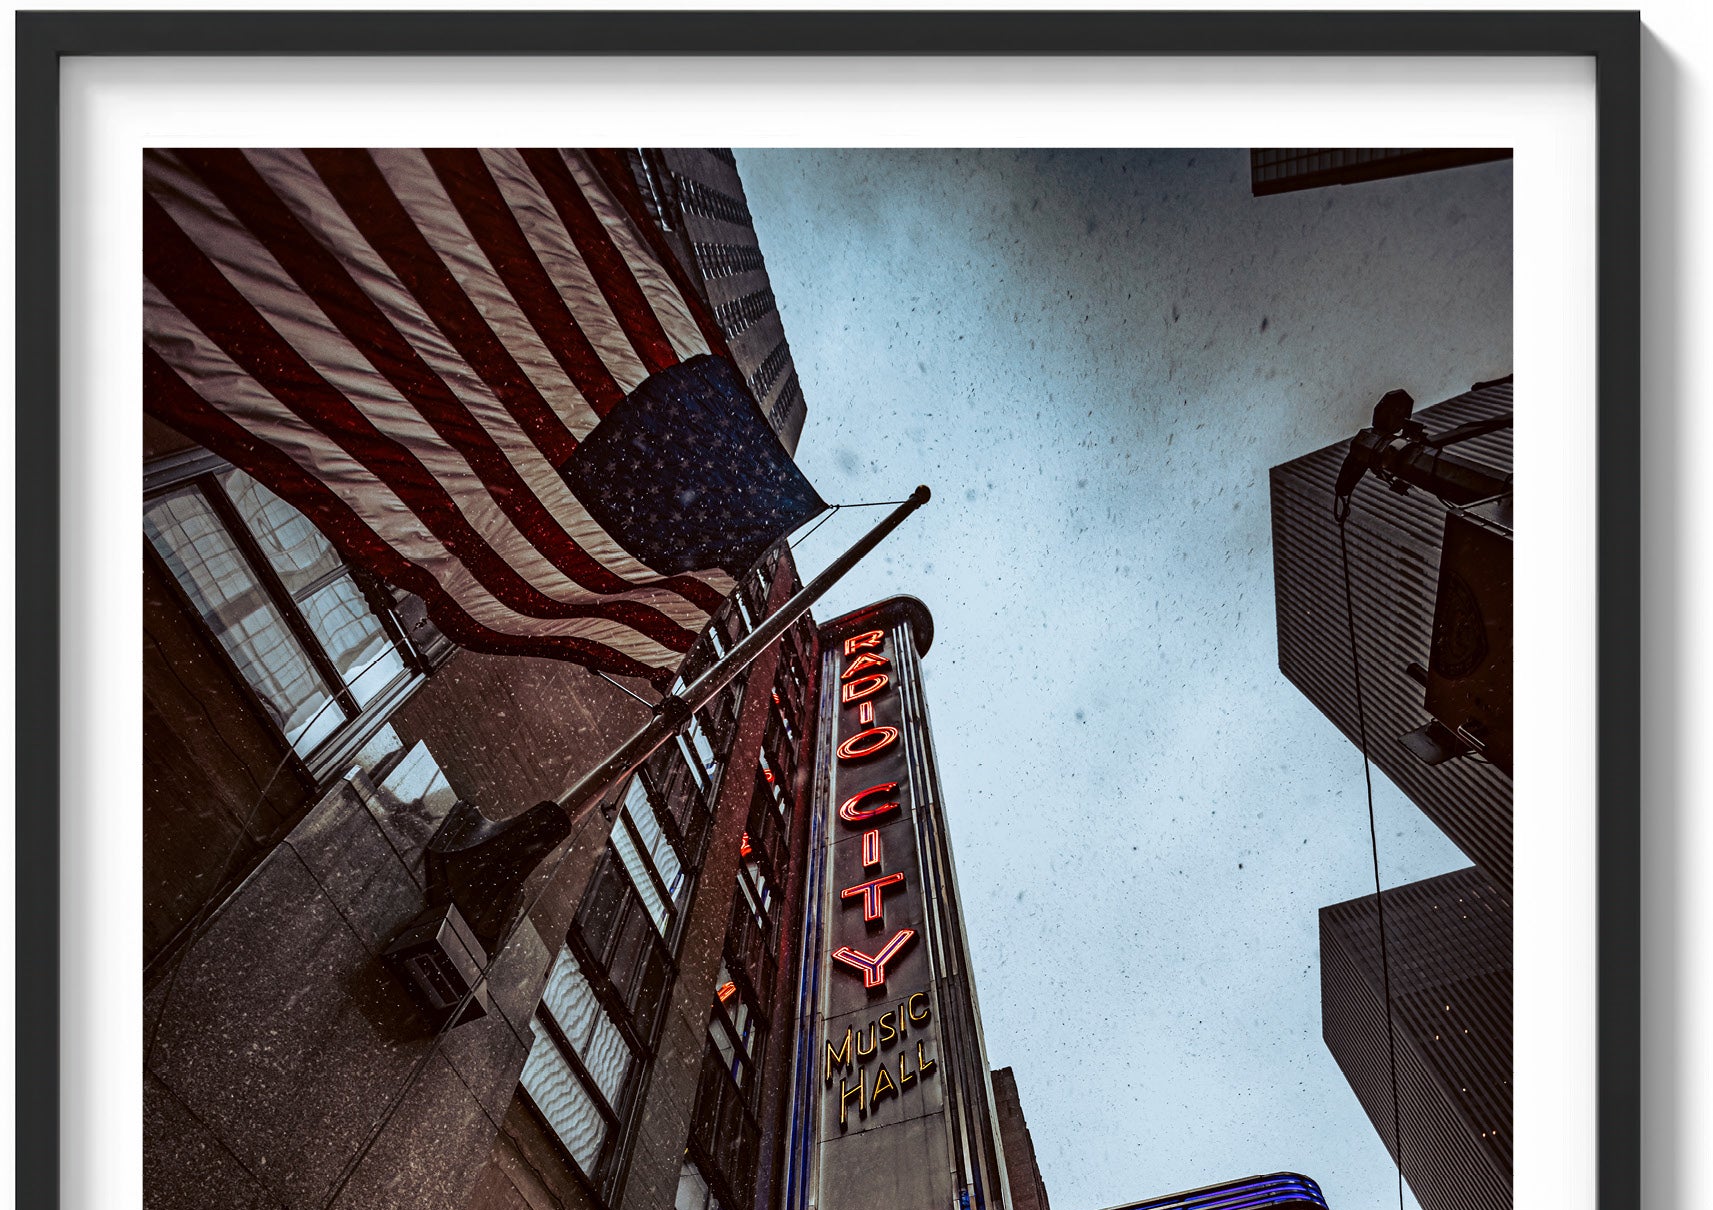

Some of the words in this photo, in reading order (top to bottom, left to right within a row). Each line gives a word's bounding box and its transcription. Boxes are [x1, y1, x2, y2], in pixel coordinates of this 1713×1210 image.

[837, 629, 899, 761] RADIO
[831, 782, 918, 991] CITY
[826, 992, 931, 1080] MUSIC
[839, 1041, 936, 1129] HALL
